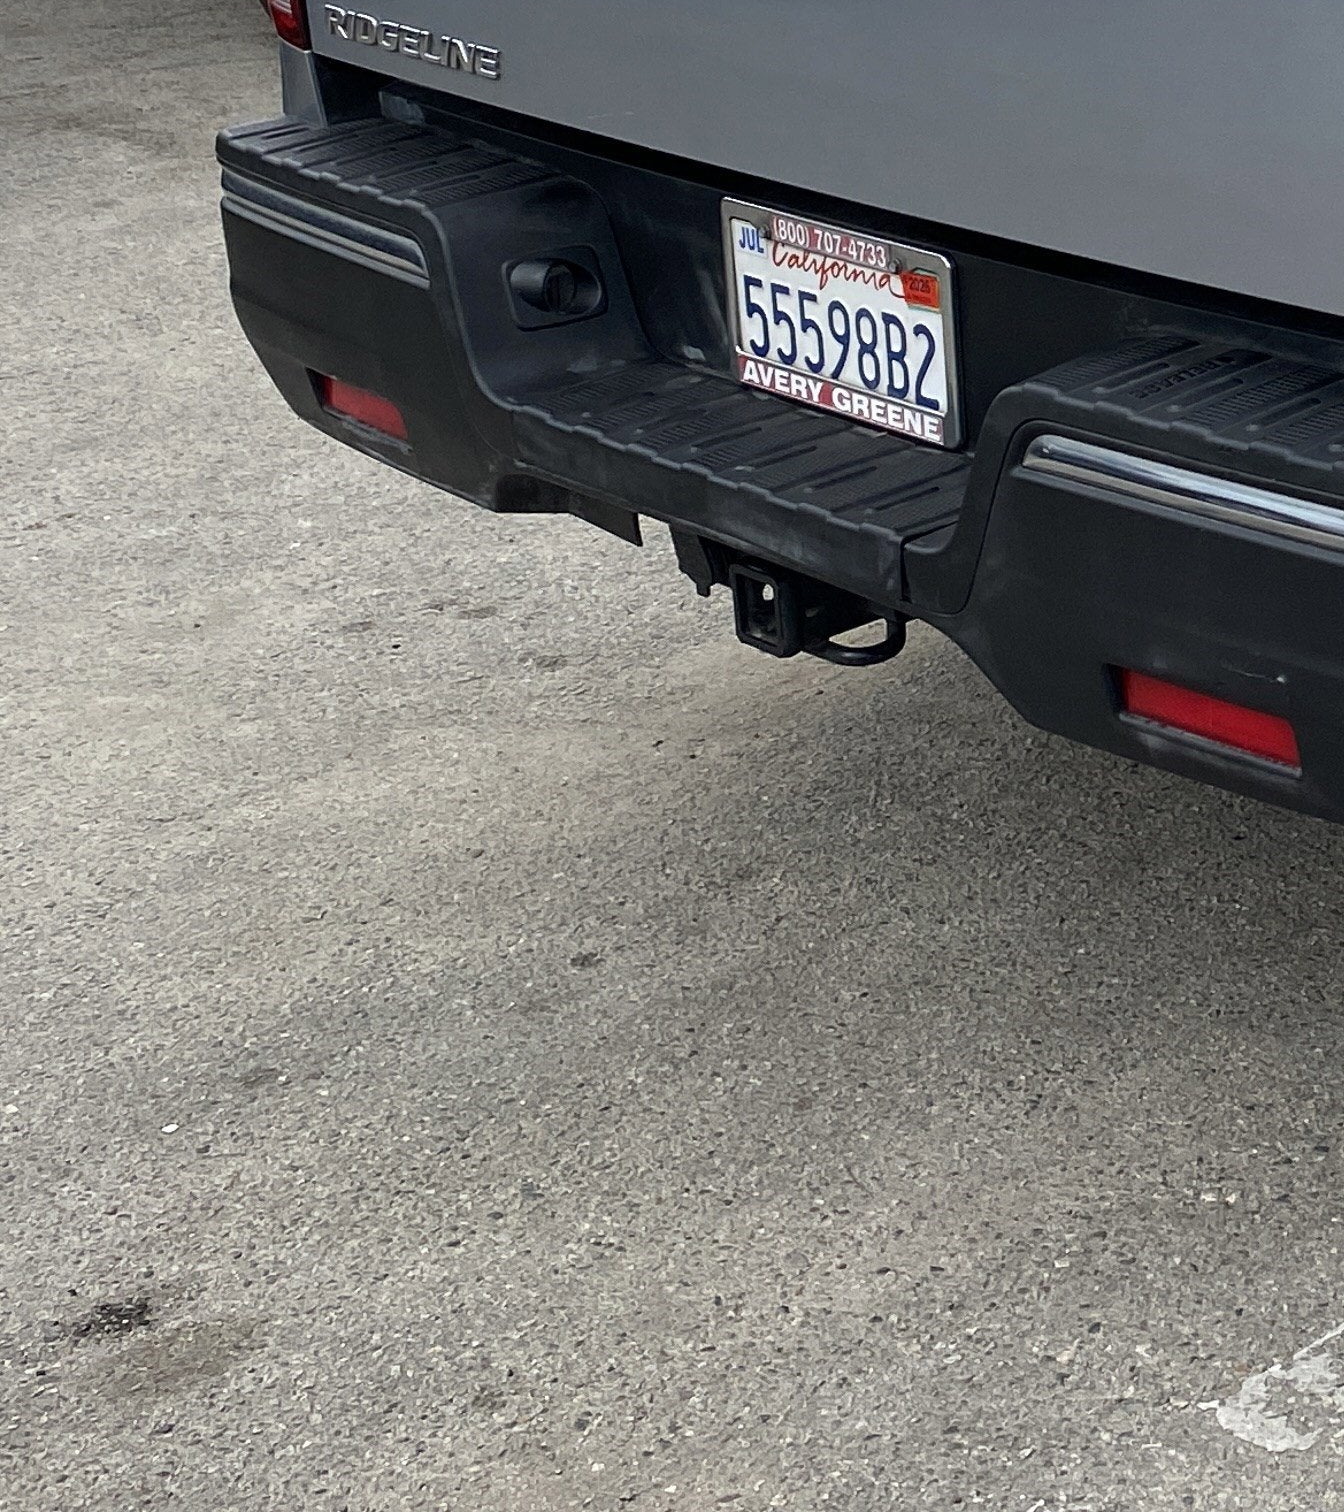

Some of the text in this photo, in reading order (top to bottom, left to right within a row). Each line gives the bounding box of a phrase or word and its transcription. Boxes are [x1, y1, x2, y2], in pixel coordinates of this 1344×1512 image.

[324, 2, 500, 80] RIDGELINE
[738, 226, 765, 254] JUL
[771, 242, 904, 298] California
[772, 216, 888, 269] (800) 707-4733
[743, 274, 940, 411] 55598B2
[742, 360, 942, 442] AVERY GREENE
